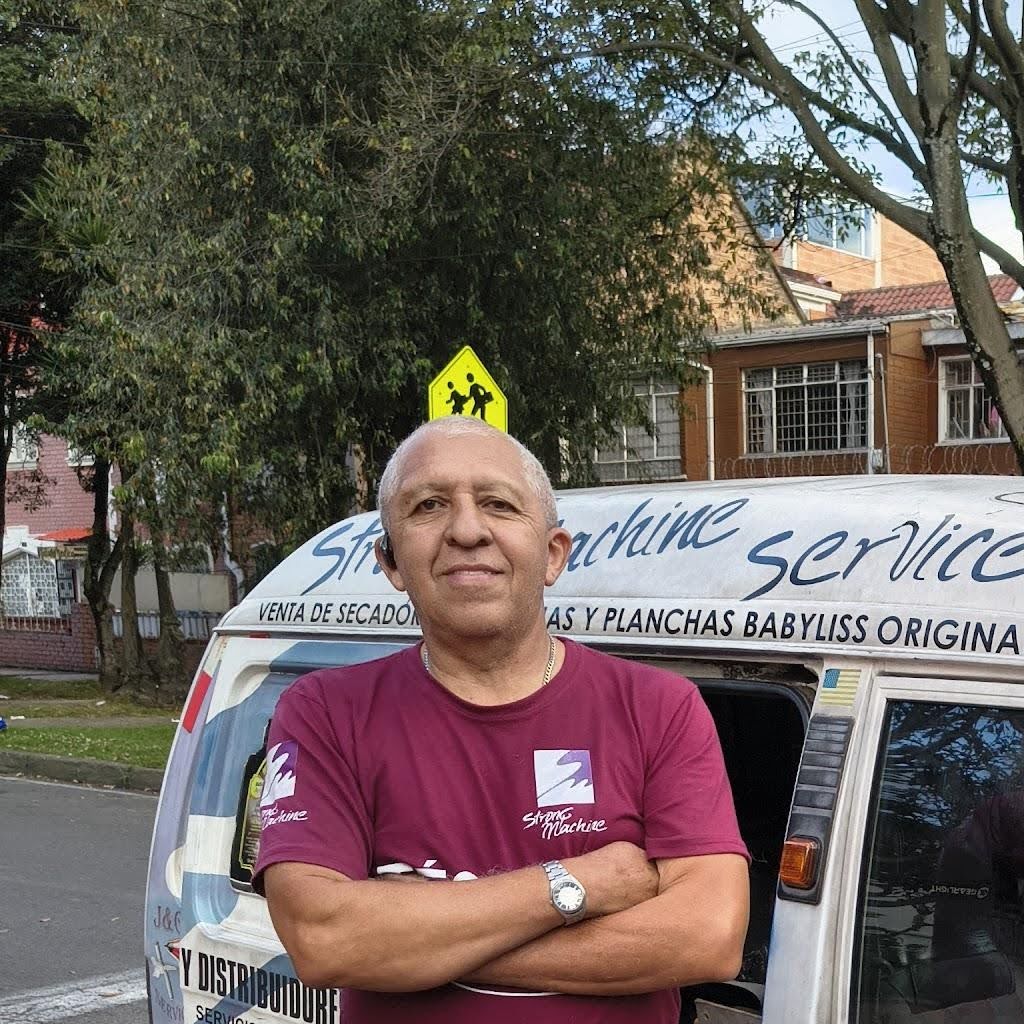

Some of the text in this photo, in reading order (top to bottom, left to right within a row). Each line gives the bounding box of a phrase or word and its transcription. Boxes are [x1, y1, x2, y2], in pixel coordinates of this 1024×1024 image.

[258, 602, 305, 623] VENTA
[311, 602, 335, 623] DE
[586, 607, 599, 632] Y
[603, 607, 736, 637] PLANCHAS
[743, 610, 869, 644] BABYLISS
[181, 947, 192, 987] Y
